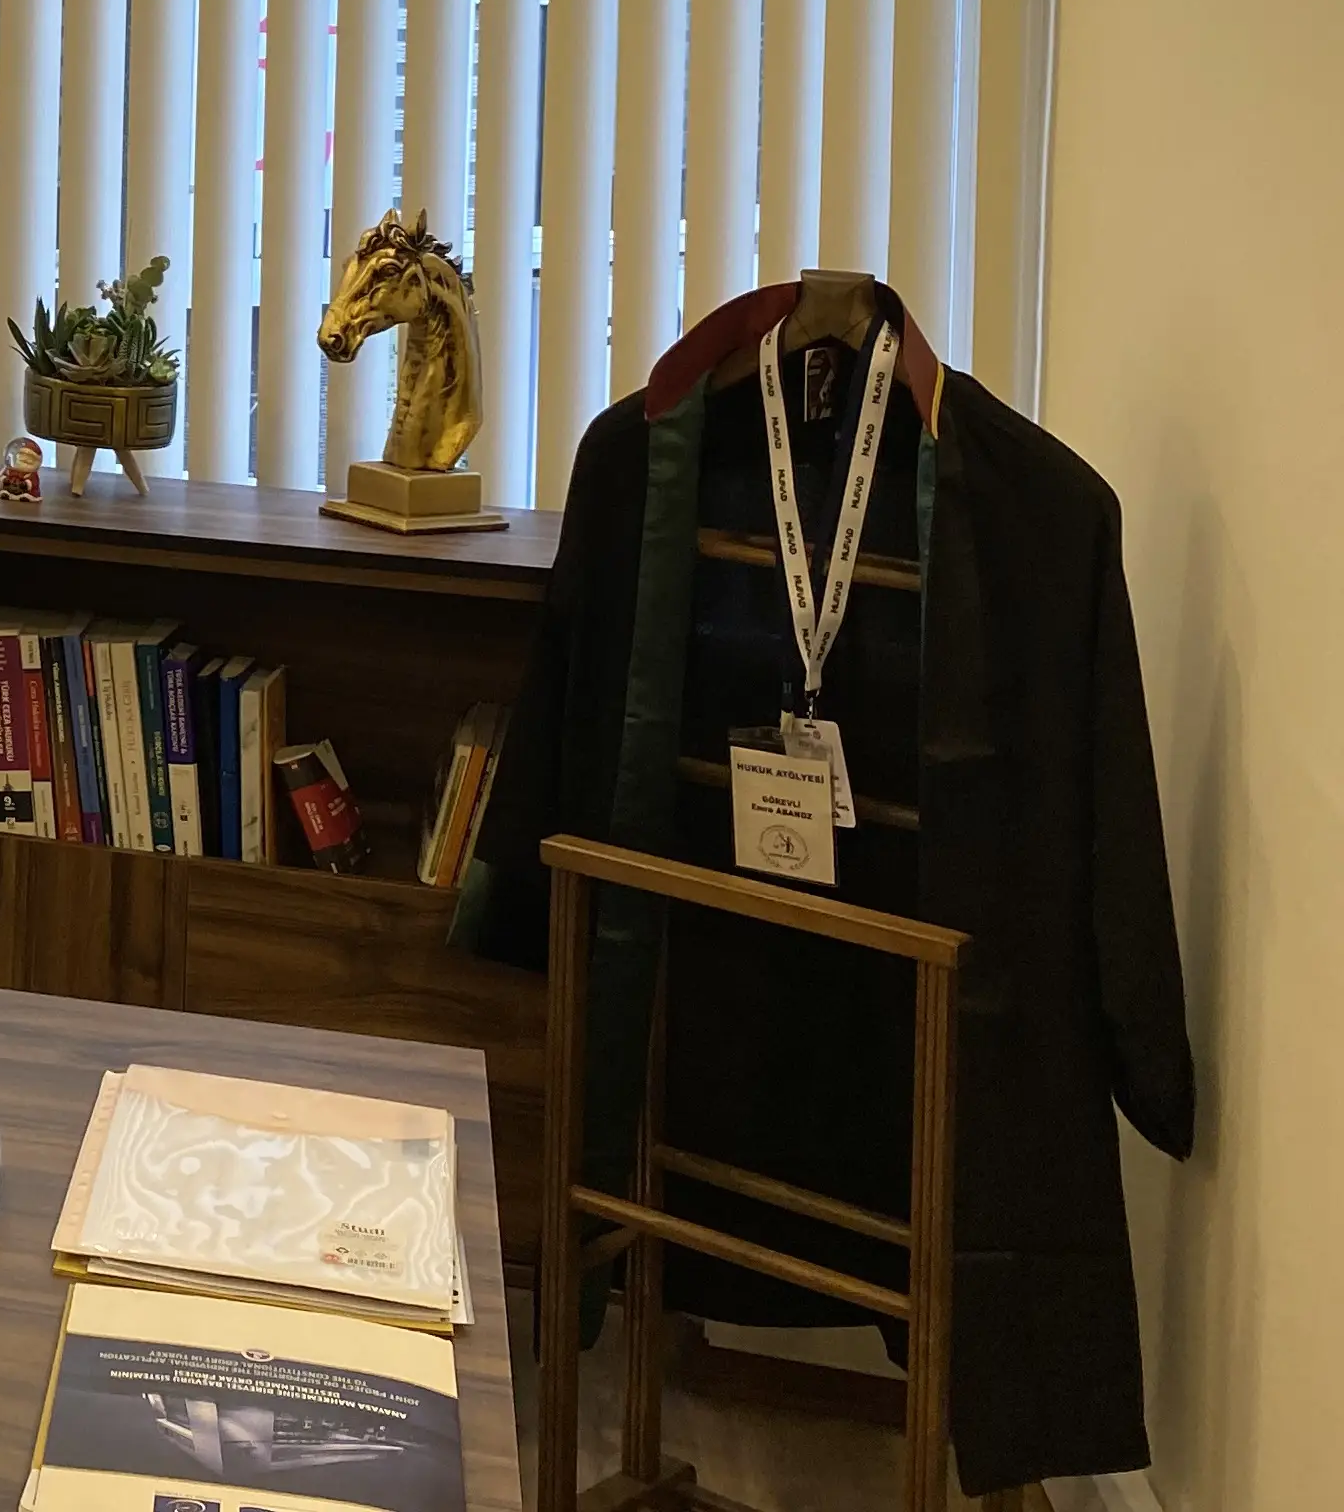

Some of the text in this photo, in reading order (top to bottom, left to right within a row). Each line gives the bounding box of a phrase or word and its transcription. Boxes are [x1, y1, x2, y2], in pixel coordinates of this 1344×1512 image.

[0, 680, 15, 762] TÜRK CEZA HUKUKU
[737, 763, 824, 784] HUKUK ATÖLYESİ
[762, 794, 801, 808] GÖREVLİ
[99, 1351, 168, 1364] APPLICATION
[110, 1370, 170, 1382] SİSTEMİNİN
[332, 1375, 351, 1384] THE
[354, 1379, 368, 1387] TO
[341, 1384, 387, 1398] PROJECT
[277, 1389, 356, 1408] MAHKEMESİNE
[389, 1394, 420, 1407] JOINT
[357, 1402, 407, 1420] ANAYASA
